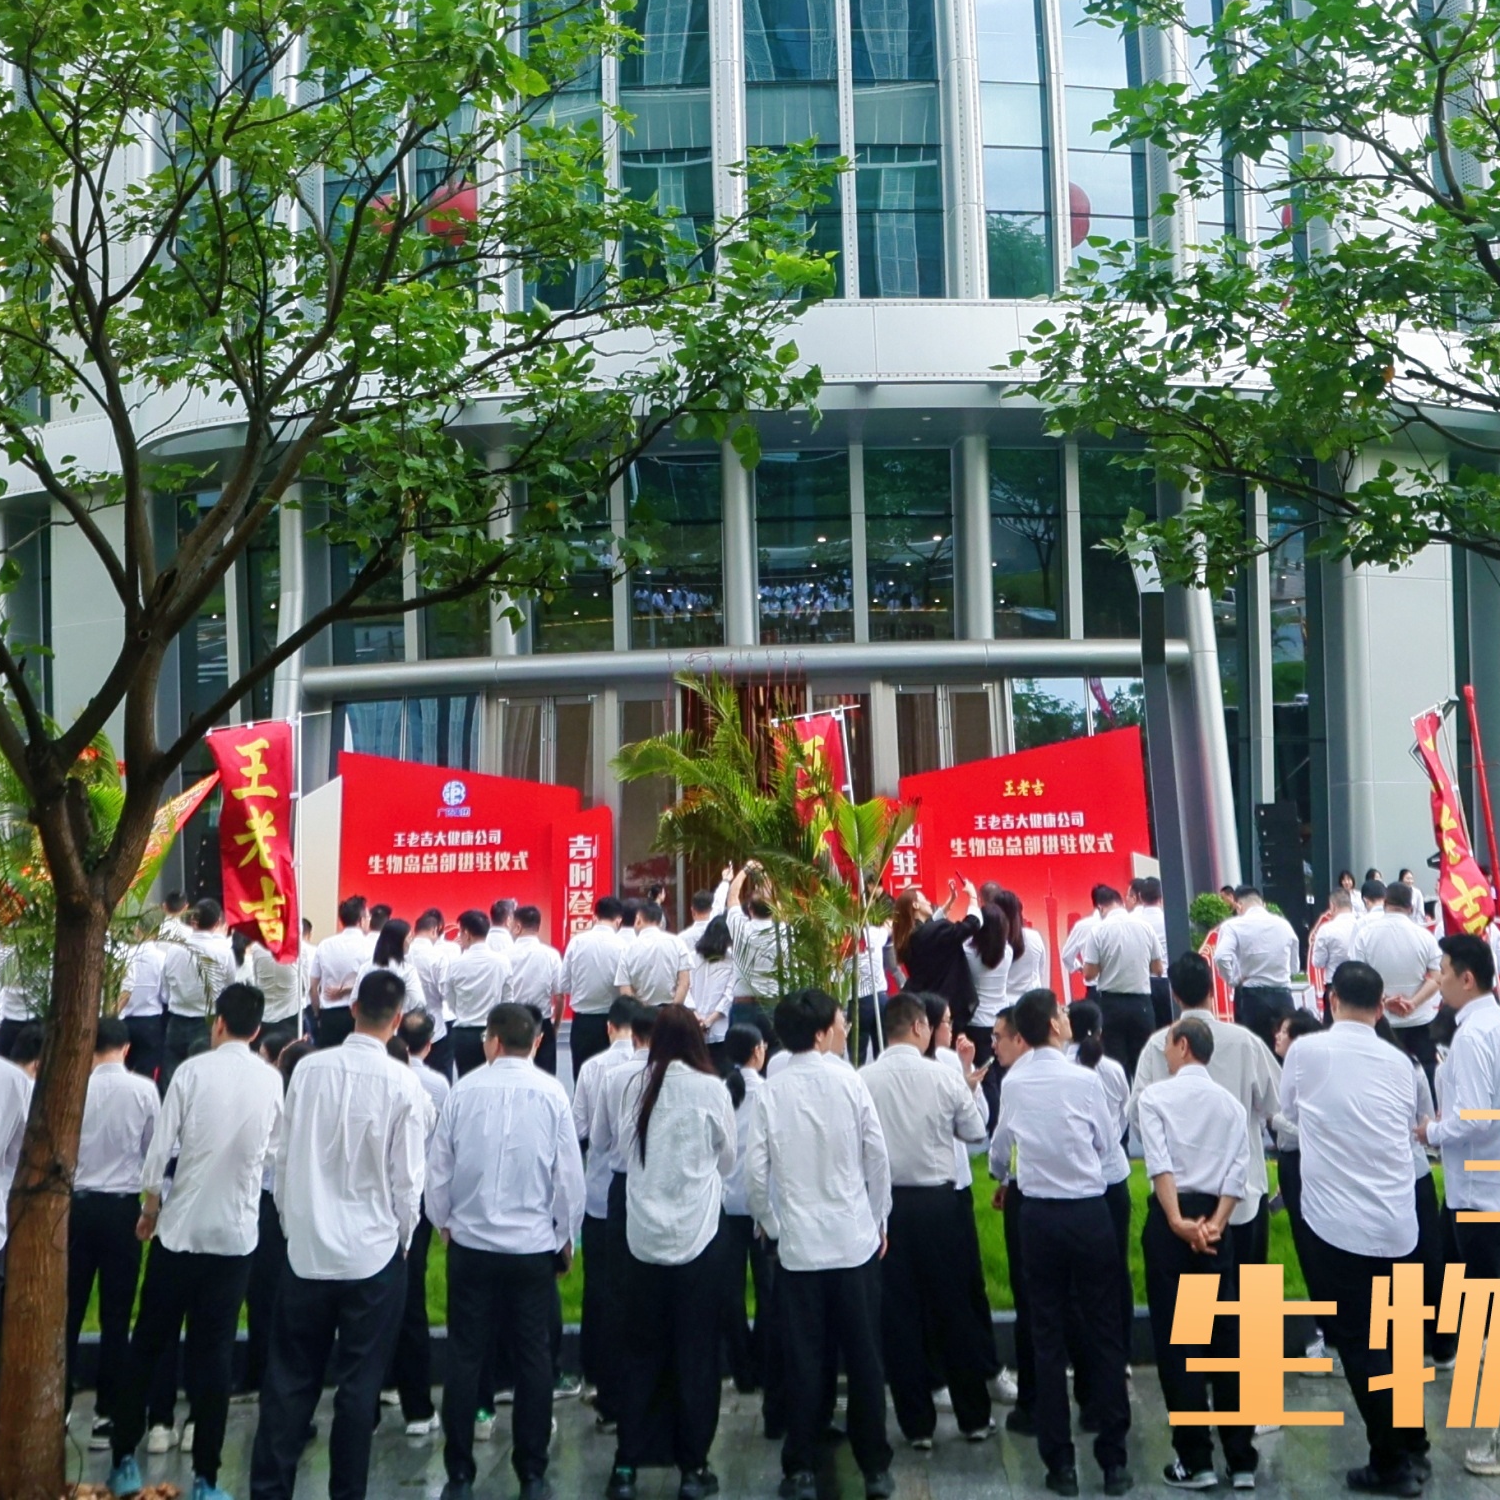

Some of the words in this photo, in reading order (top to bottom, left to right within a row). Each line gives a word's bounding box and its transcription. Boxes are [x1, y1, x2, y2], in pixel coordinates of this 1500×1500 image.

[1002, 779, 1045, 797] 王老吉
[973, 812, 1085, 831] 王老吉大健康公司
[232, 738, 286, 946] 王老吉
[393, 829, 502, 848] 王老吉大健康公司
[950, 834, 1115, 858] 生物岛总部进驻仪式
[367, 851, 529, 875] 生物岛总部进驻仪式
